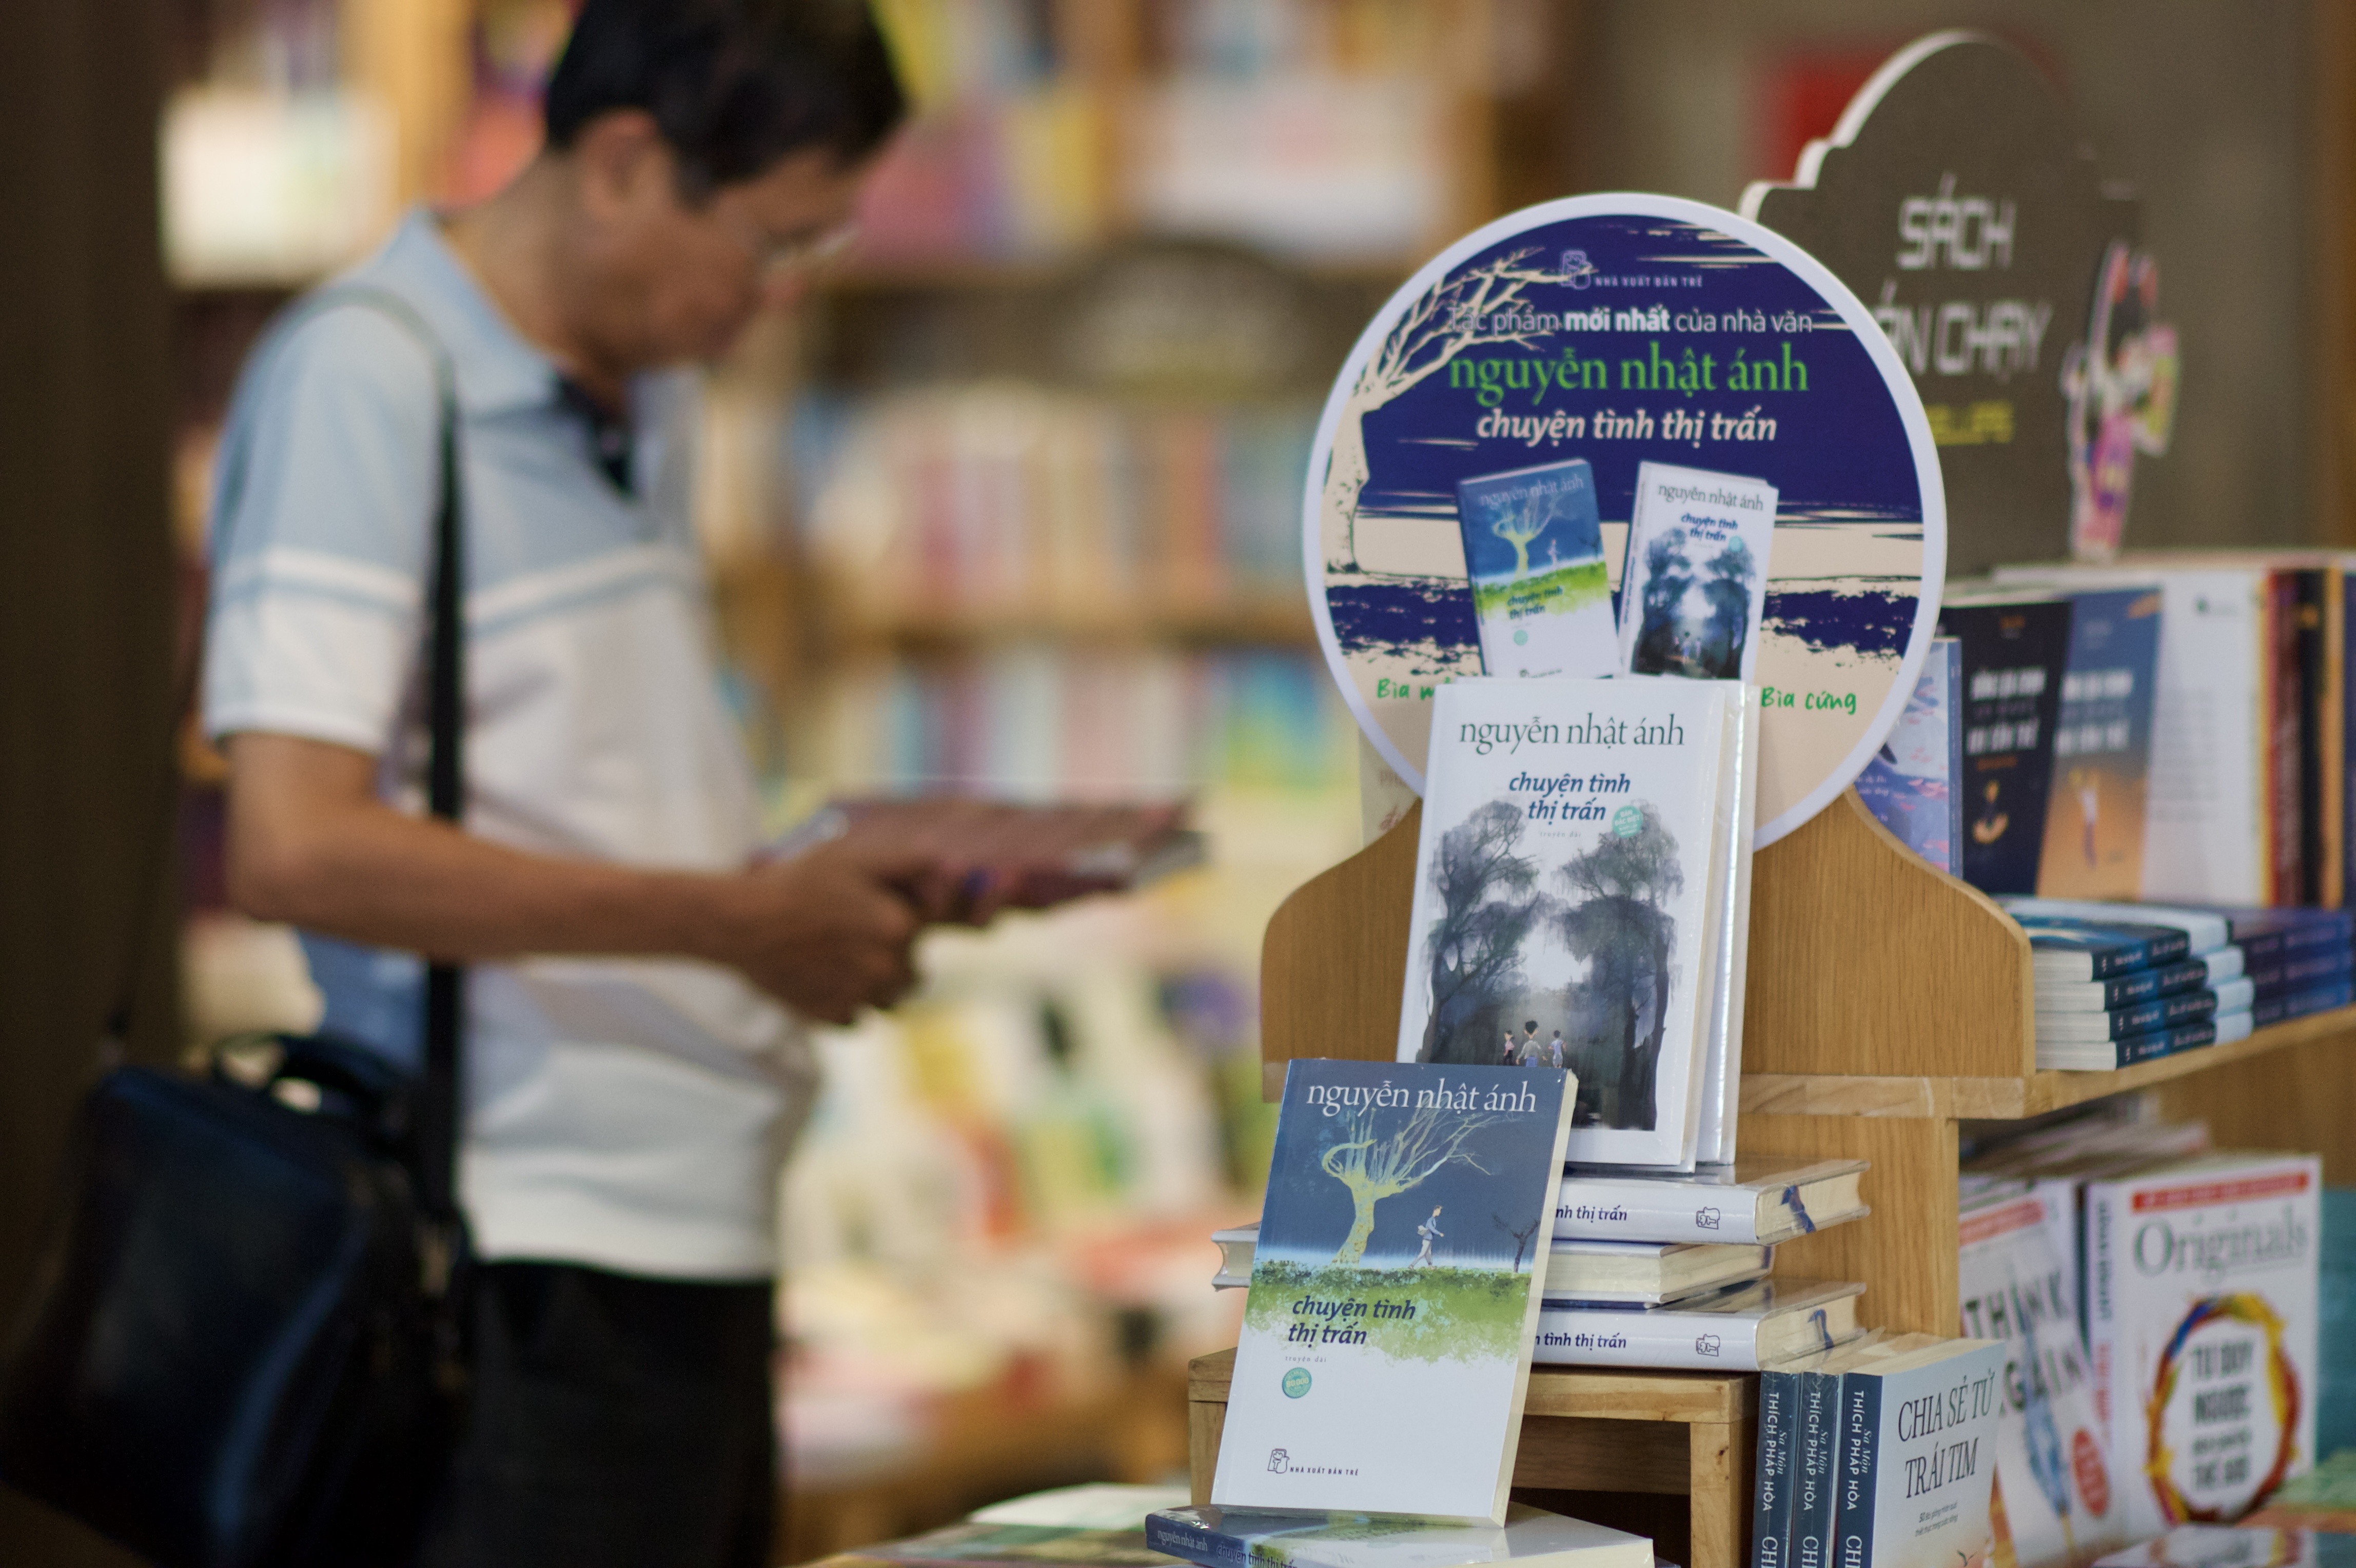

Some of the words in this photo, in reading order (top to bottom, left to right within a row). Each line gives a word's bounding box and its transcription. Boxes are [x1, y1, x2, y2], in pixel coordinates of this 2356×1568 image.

[1897, 172, 2017, 270] SÁCH
[1596, 274, 1619, 287] NHÀ
[1448, 308, 1486, 331] Tác
[1494, 304, 1559, 339] phẩm
[1565, 308, 1611, 332] mới
[1615, 304, 1671, 332] nhất
[1674, 308, 1716, 332] của
[1722, 309, 1766, 333] nhà
[1771, 310, 1812, 333] văn
[1870, 278, 1932, 375] ÁN
[1449, 346, 1608, 407] nguyễn
[1620, 341, 1716, 397] nhật
[1727, 342, 1809, 391] ánh
[1476, 408, 1585, 447] chuyện
[1594, 408, 1654, 439] tình
[1662, 408, 1705, 448] thị
[1711, 404, 1777, 441] trấn
[1709, 488, 1737, 508] nhật
[1740, 494, 1763, 511] ánh
[1805, 691, 1856, 715] cứng
[1460, 716, 1559, 756] nguyễn
[1566, 712, 1628, 749] nhật
[1634, 713, 1685, 746] ánh
[1509, 772, 1583, 798] chuyện
[1589, 773, 1631, 793] tình
[1528, 799, 1558, 825] thị
[1562, 797, 1606, 820] trấn
[1306, 1080, 1409, 1117] nguyễn
[1416, 1078, 1479, 1114] nhật
[1484, 1081, 1537, 1112] ánh
[1555, 1205, 1573, 1219] nh
[1577, 1205, 1596, 1223] thị
[1599, 1205, 1627, 1221] trấn
[1292, 1295, 1368, 1322] chuyện
[1372, 1299, 1416, 1320] tình
[1288, 1322, 1319, 1348] thị
[1322, 1321, 1367, 1345] trấn
[1544, 1332, 1572, 1347] tình
[1575, 1333, 1594, 1350] thị
[1597, 1332, 1626, 1348] trấn
[1767, 1391, 1780, 1435] THÍCH
[1808, 1391, 1822, 1434] THÍCH
[1852, 1390, 1865, 1434] THÍCH
[1898, 1392, 1943, 1442] CHIA
[1947, 1375, 1969, 1428] SẺ
[1972, 1367, 1995, 1420] TỪ
[1779, 1430, 1788, 1445] Sa
[1820, 1429, 1828, 1445] Sa
[1863, 1428, 1872, 1444] Sa
[1307, 1466, 1325, 1474] XUẤT
[1765, 1440, 1779, 1477] PHÁP
[1777, 1448, 1786, 1475] Môn
[1805, 1439, 1820, 1476] PHÁP
[1818, 1448, 1828, 1474] Môn
[1850, 1438, 1863, 1476] PHÁP
[1861, 1447, 1871, 1474] Môn
[1905, 1441, 1946, 1498] TRÁI
[1948, 1437, 1979, 1484] TIM
[1762, 1481, 1776, 1511] HÒA
[1803, 1481, 1817, 1511] HÒA
[1847, 1480, 1860, 1510] HÒA
[1248, 1551, 1265, 1567] tình
